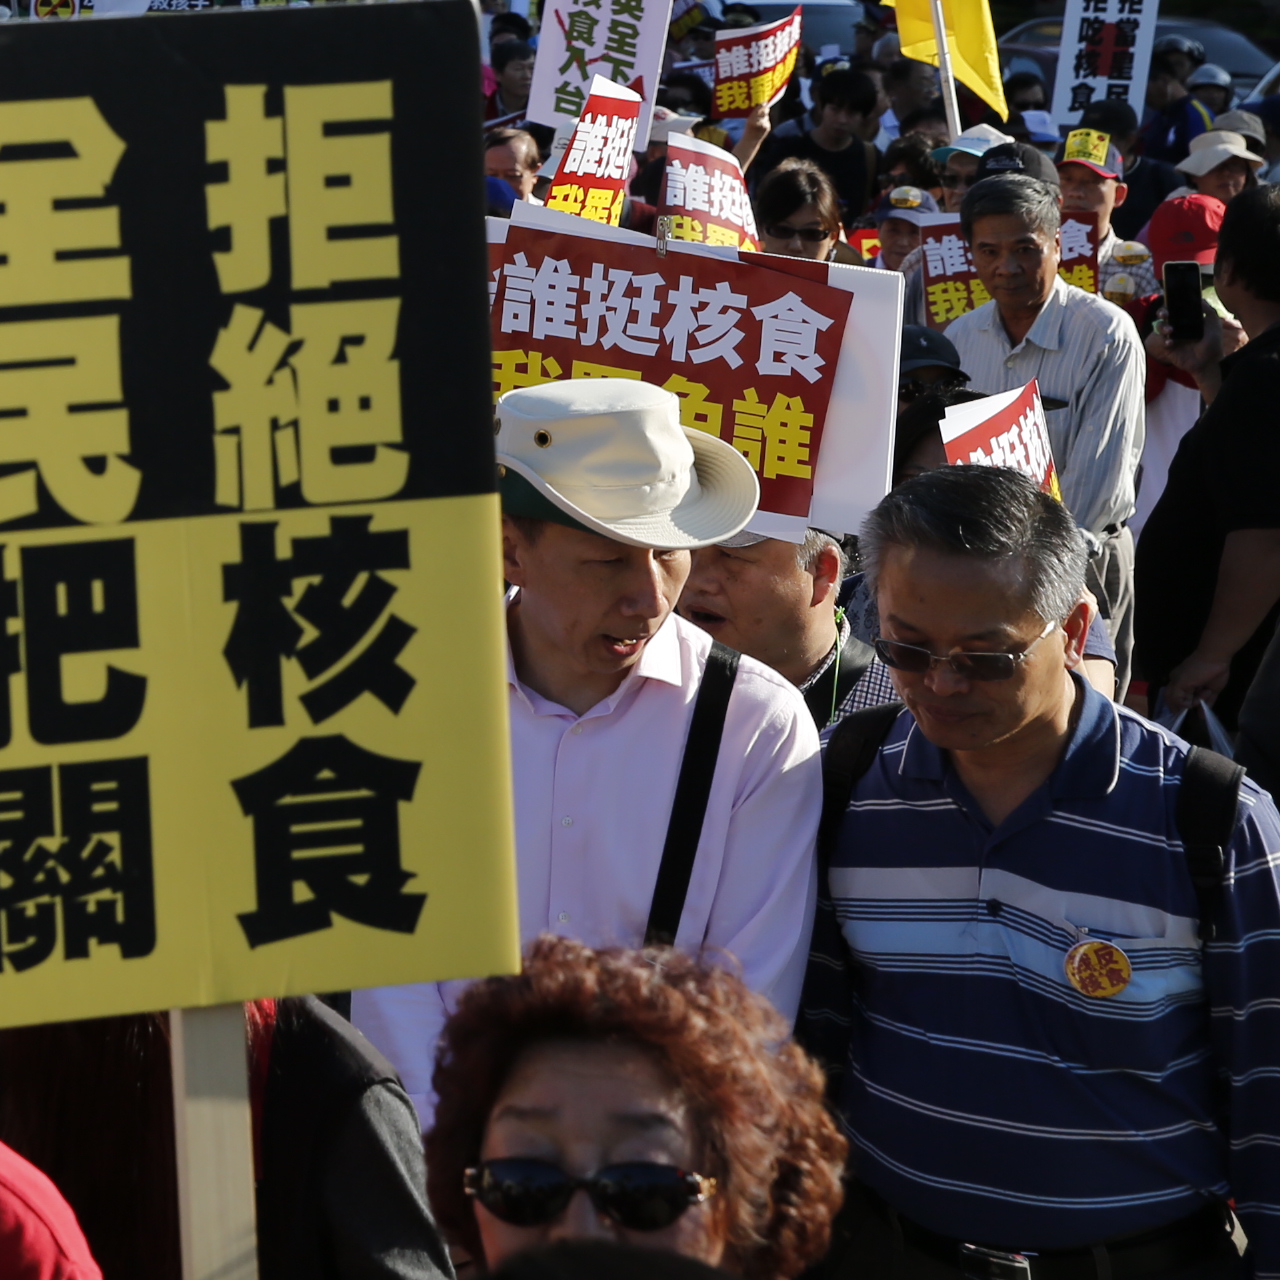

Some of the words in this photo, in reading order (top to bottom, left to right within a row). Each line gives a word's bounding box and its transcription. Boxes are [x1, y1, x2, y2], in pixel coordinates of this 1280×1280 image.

[563, 112, 638, 181] 誰挺
[665, 159, 759, 241] 誰挺
[500, 250, 835, 385] 誰挺核食
[203, 79, 429, 949] 拒絕核食
